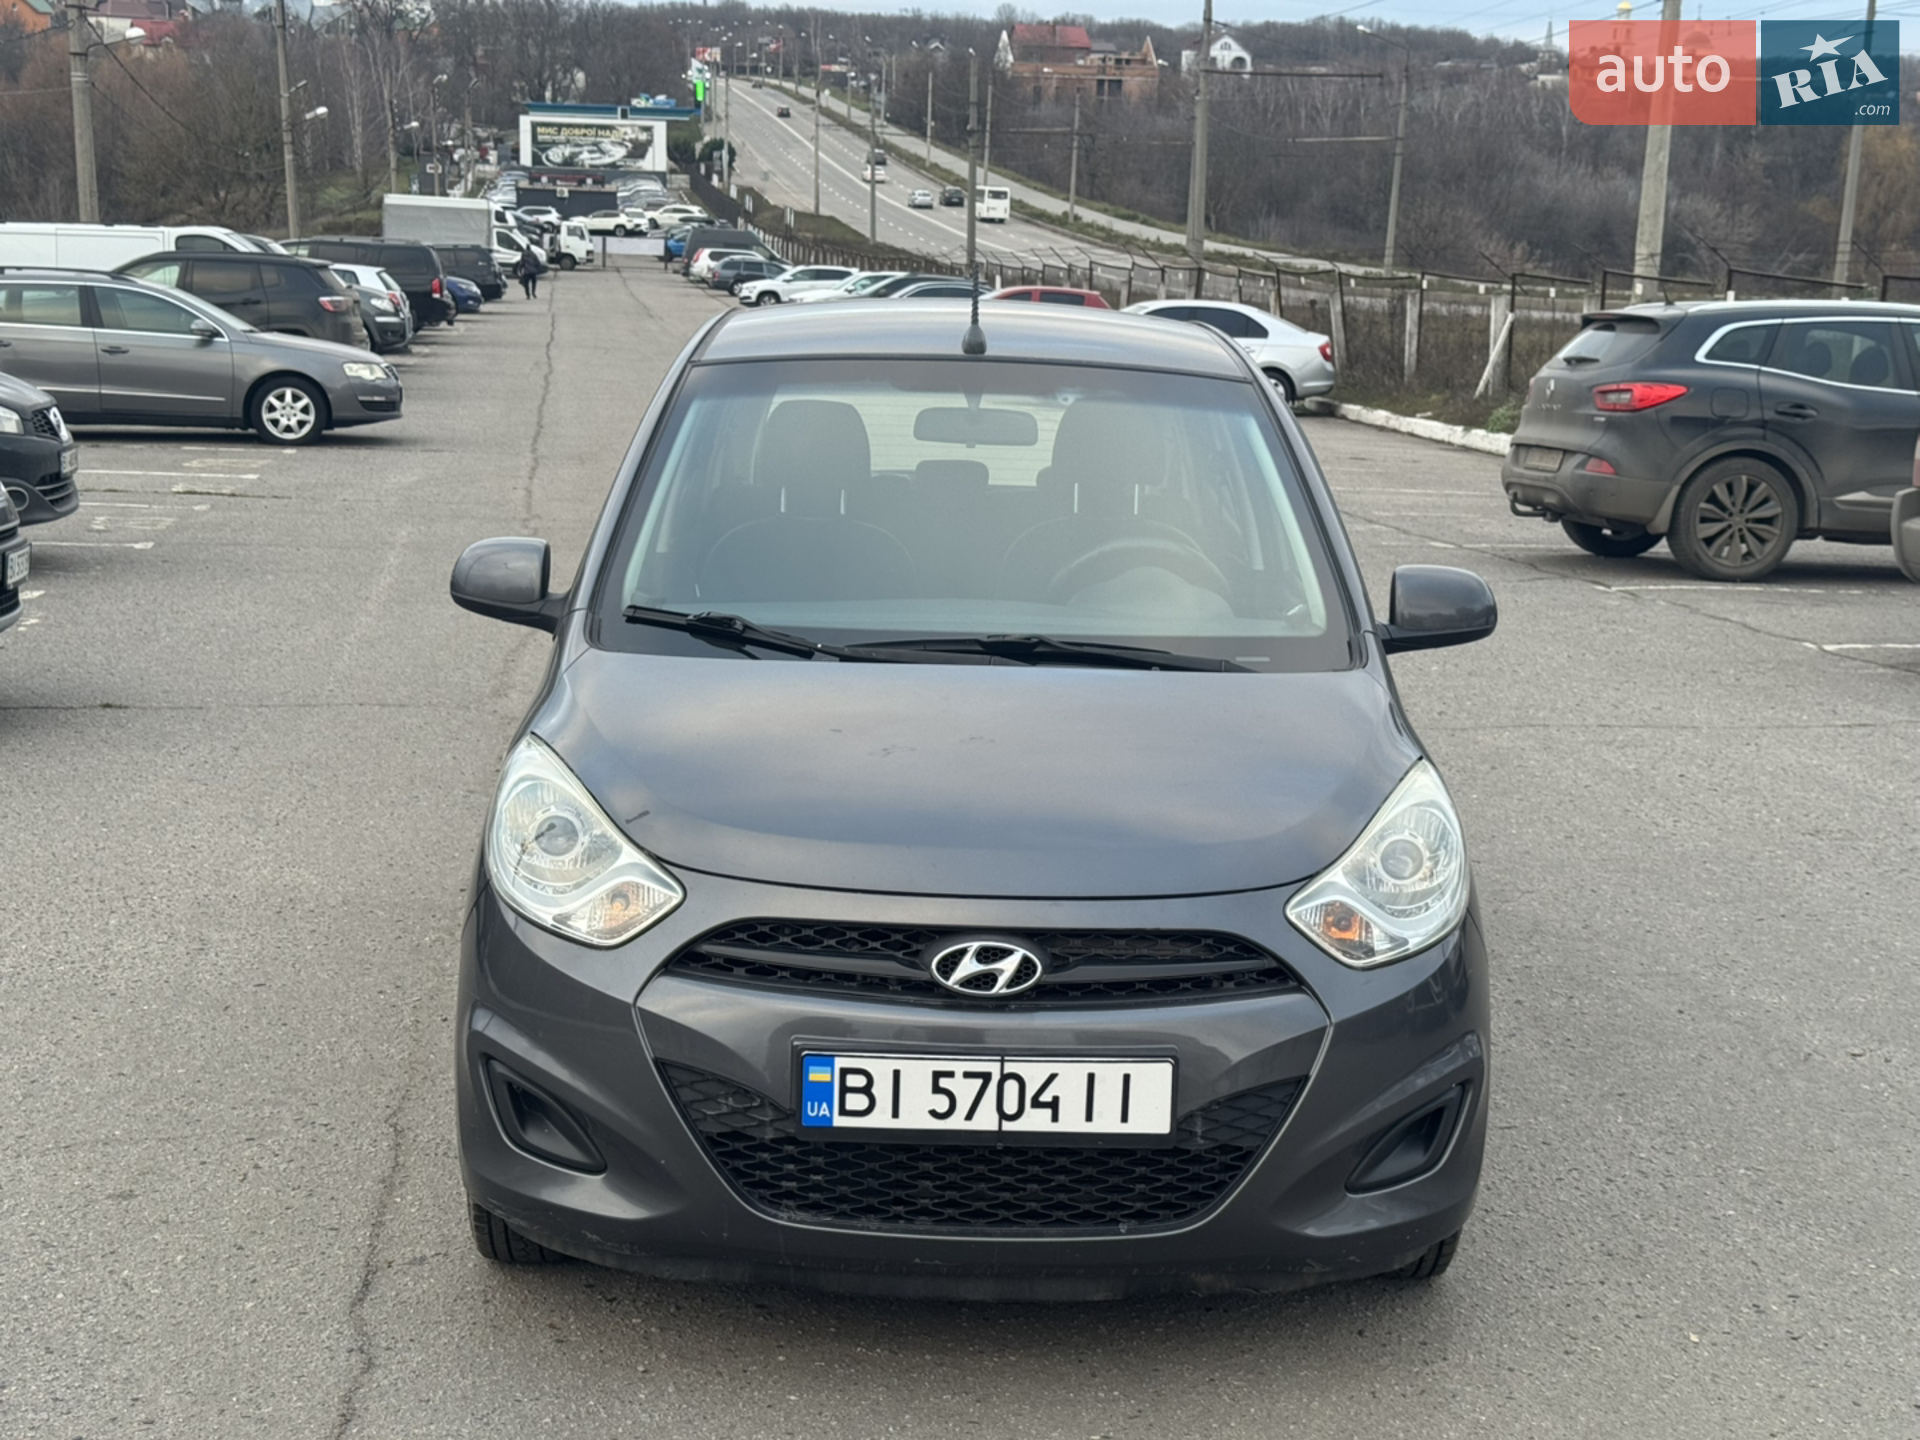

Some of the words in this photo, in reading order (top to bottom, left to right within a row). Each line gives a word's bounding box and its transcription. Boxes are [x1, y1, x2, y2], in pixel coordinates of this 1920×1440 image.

[537, 126, 559, 135] МИС
[560, 127, 597, 137] ДОБРОЇ
[838, 1066, 901, 1119] BI
[928, 1070, 1060, 1123] 5704
[1085, 1072, 1131, 1124] II
[807, 1101, 831, 1117] UA
